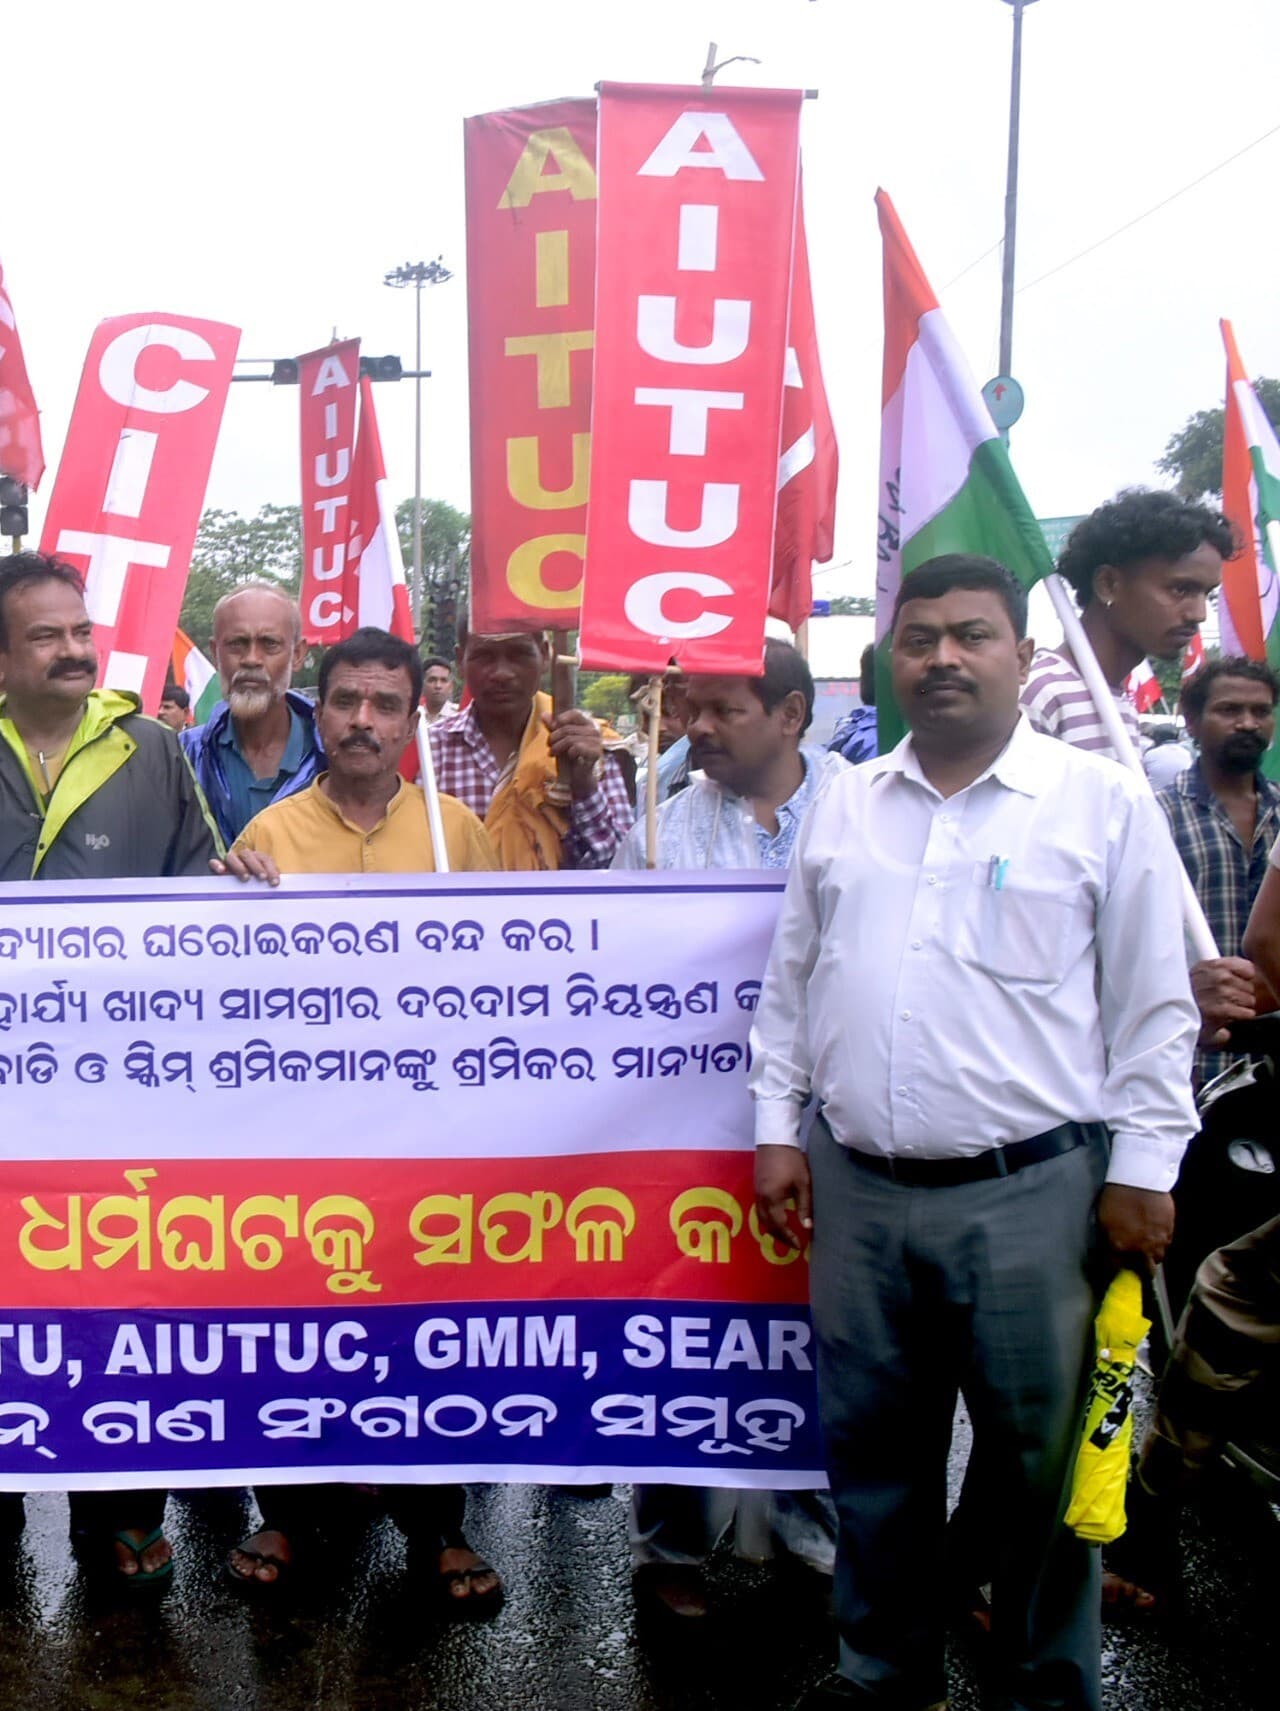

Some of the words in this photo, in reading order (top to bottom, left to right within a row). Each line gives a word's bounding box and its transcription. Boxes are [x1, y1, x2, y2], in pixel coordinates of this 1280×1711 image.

[497, 126, 598, 610] AITUC
[624, 111, 765, 639] AIUTUC
[56, 324, 216, 694] CIT
[308, 355, 351, 628] AIUTUC
[501, 918, 575, 954] କର
[103, 989, 203, 1022] ଖାଦ୍ୟ
[397, 984, 549, 1020] ଦରଦାମ
[75, 1052, 108, 1083] ଓ
[20, 1169, 381, 1293] ଧର୍ମଘଟକୁ
[411, 1188, 636, 1265] ସଫଳ
[104, 1321, 388, 1382] AIUTUC,
[415, 1316, 597, 1379] GMM,
[82, 1400, 224, 1444] ଗଣ
[258, 1395, 557, 1438] ସଂଗଠନ
